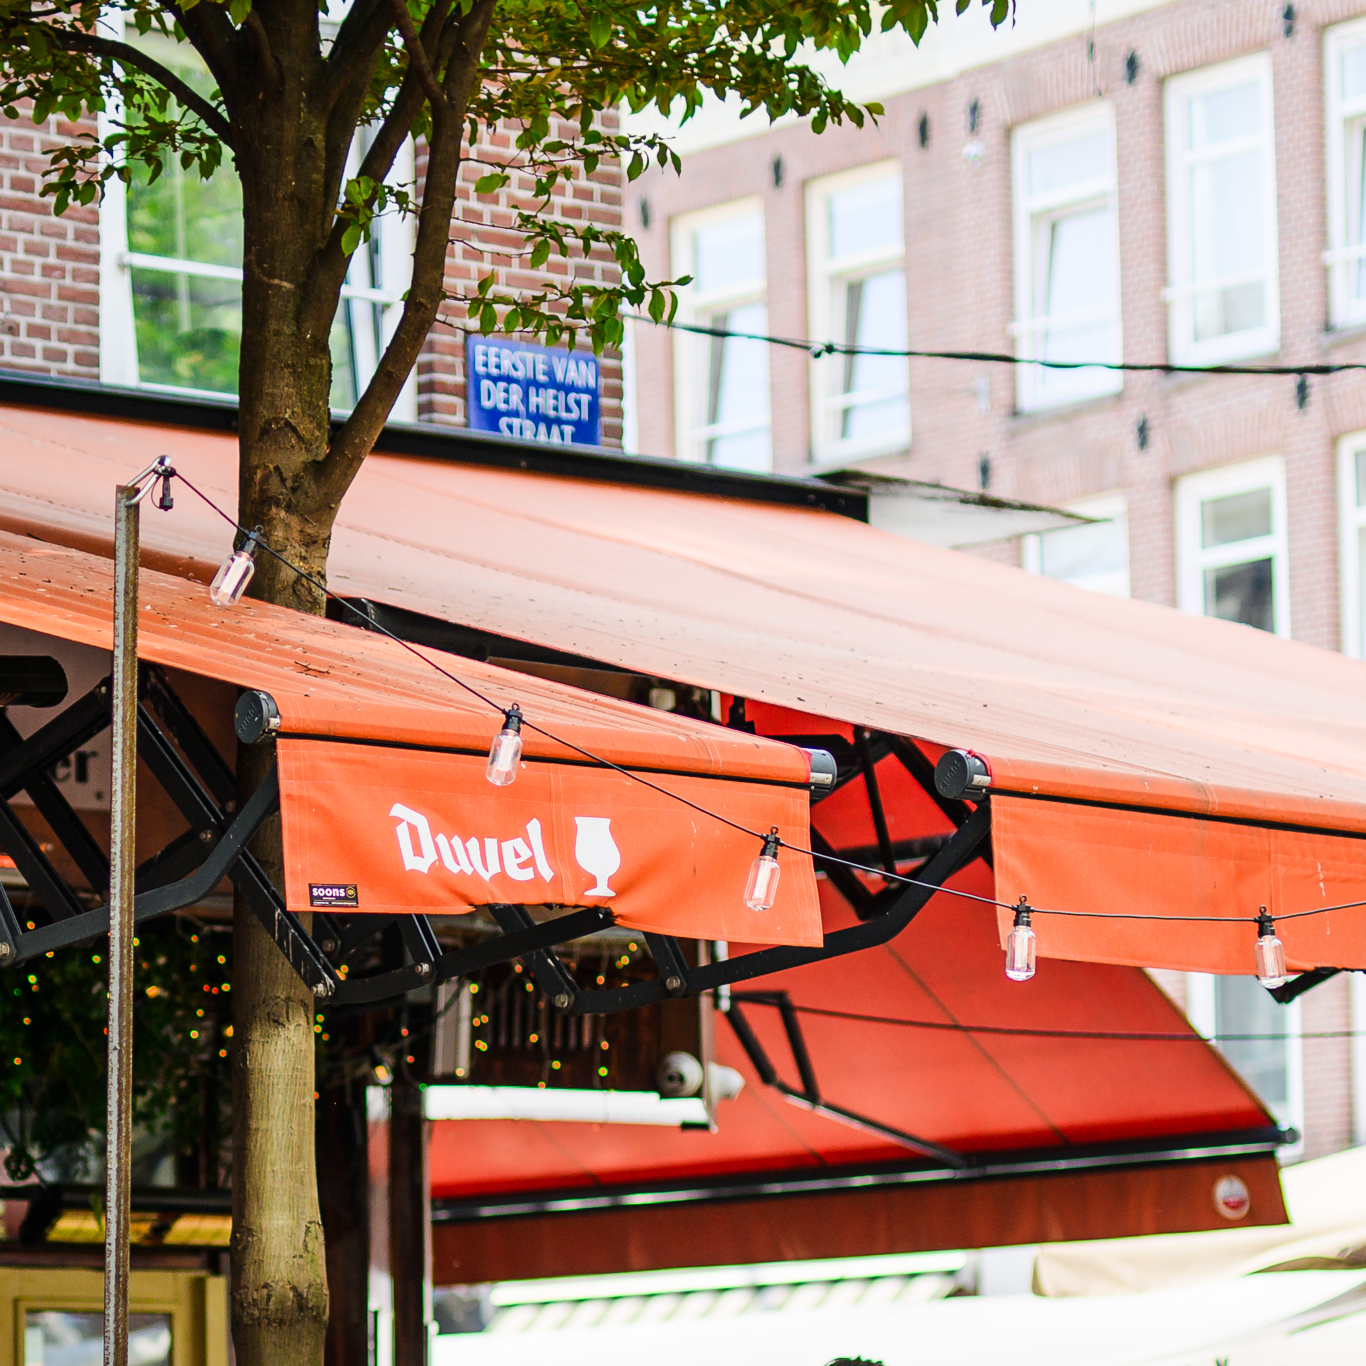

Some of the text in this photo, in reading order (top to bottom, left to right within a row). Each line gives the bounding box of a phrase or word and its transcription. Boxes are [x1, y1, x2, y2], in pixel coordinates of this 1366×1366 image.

[474, 344, 596, 389] EERSTE VAN
[480, 379, 592, 422] DER HELST
[498, 416, 576, 446] STRAAT
[388, 802, 554, 883] Duvel
[312, 887, 345, 897] soons
